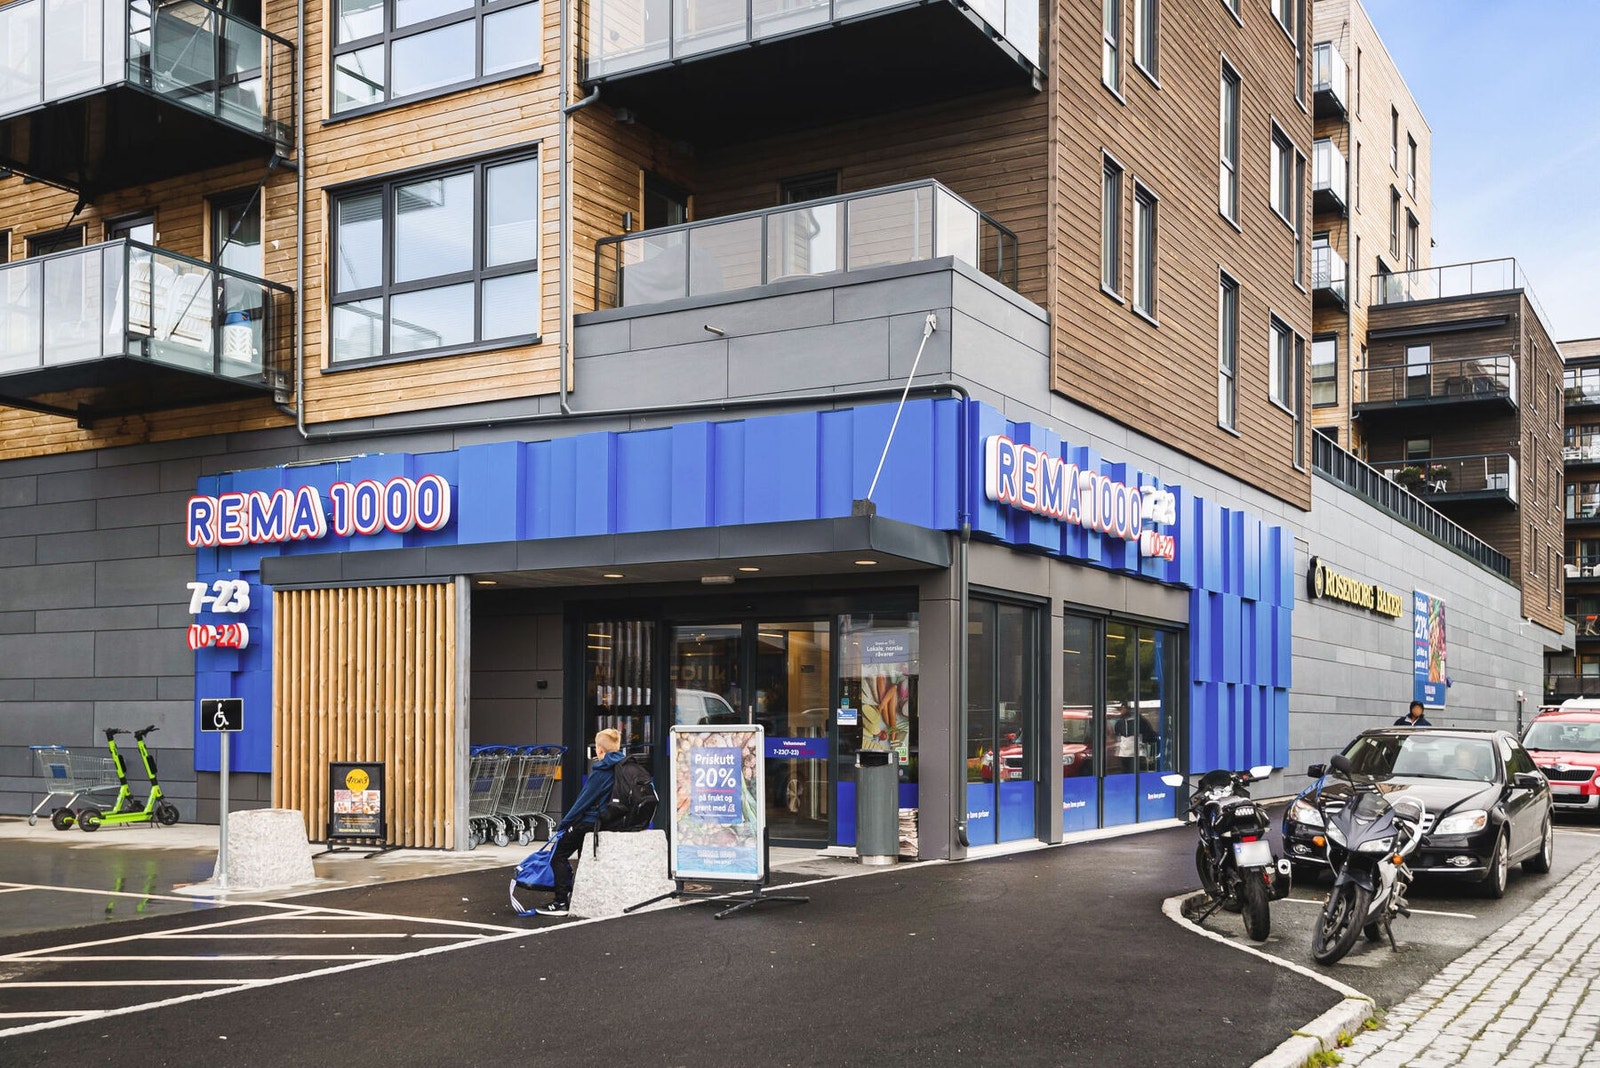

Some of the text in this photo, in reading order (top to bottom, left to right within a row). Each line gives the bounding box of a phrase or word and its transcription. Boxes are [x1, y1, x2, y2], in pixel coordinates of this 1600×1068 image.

[985, 434, 1142, 541] REMA 1000
[186, 474, 450, 548] REMA 1000
[186, 579, 250, 614] 7-23
[1325, 566, 1403, 618] ROSENBORG BAKERI
[186, 622, 249, 651] (10-22)
[695, 753, 735, 765] Priskutt
[695, 767, 736, 788] 20%
[707, 793, 724, 802] frukt
[713, 804, 726, 812] med
